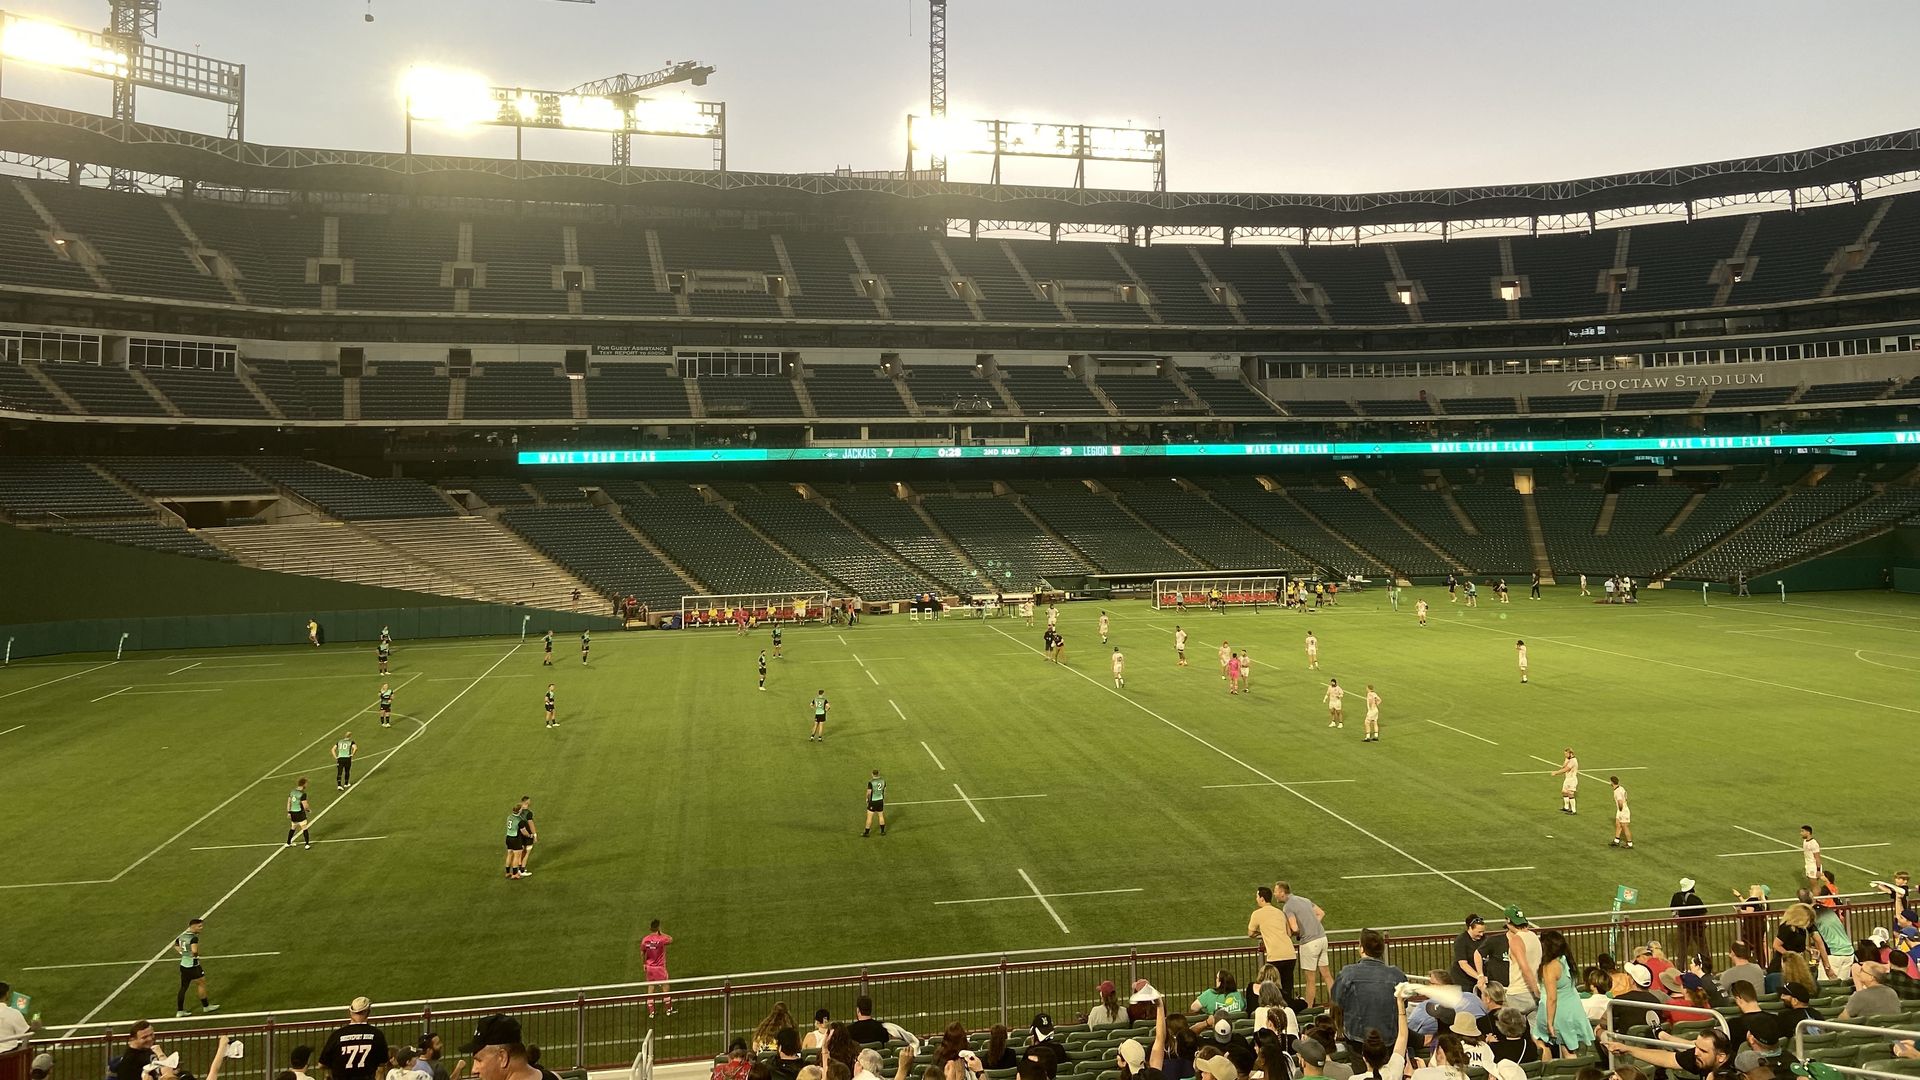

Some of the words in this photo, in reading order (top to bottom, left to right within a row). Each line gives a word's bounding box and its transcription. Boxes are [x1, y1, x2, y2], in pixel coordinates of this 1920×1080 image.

[1577, 376, 1669, 391] CHOCTAW
[1675, 373, 1764, 388] STADIUM
[1430, 442, 1462, 453] WAVE
[1658, 438, 1691, 449] WAVE
[1741, 436, 1771, 447] FLAG
[843, 448, 877, 458] JACKALS
[886, 448, 894, 457] 7
[938, 448, 962, 458] 0:28
[1060, 447, 1073, 456] 29
[1083, 446, 1108, 456] LEGION
[1246, 444, 1272, 455] WAVE
[539, 452, 574, 464] WAVE
[583, 452, 616, 463] YOUR
[623, 451, 656, 463] FLAG
